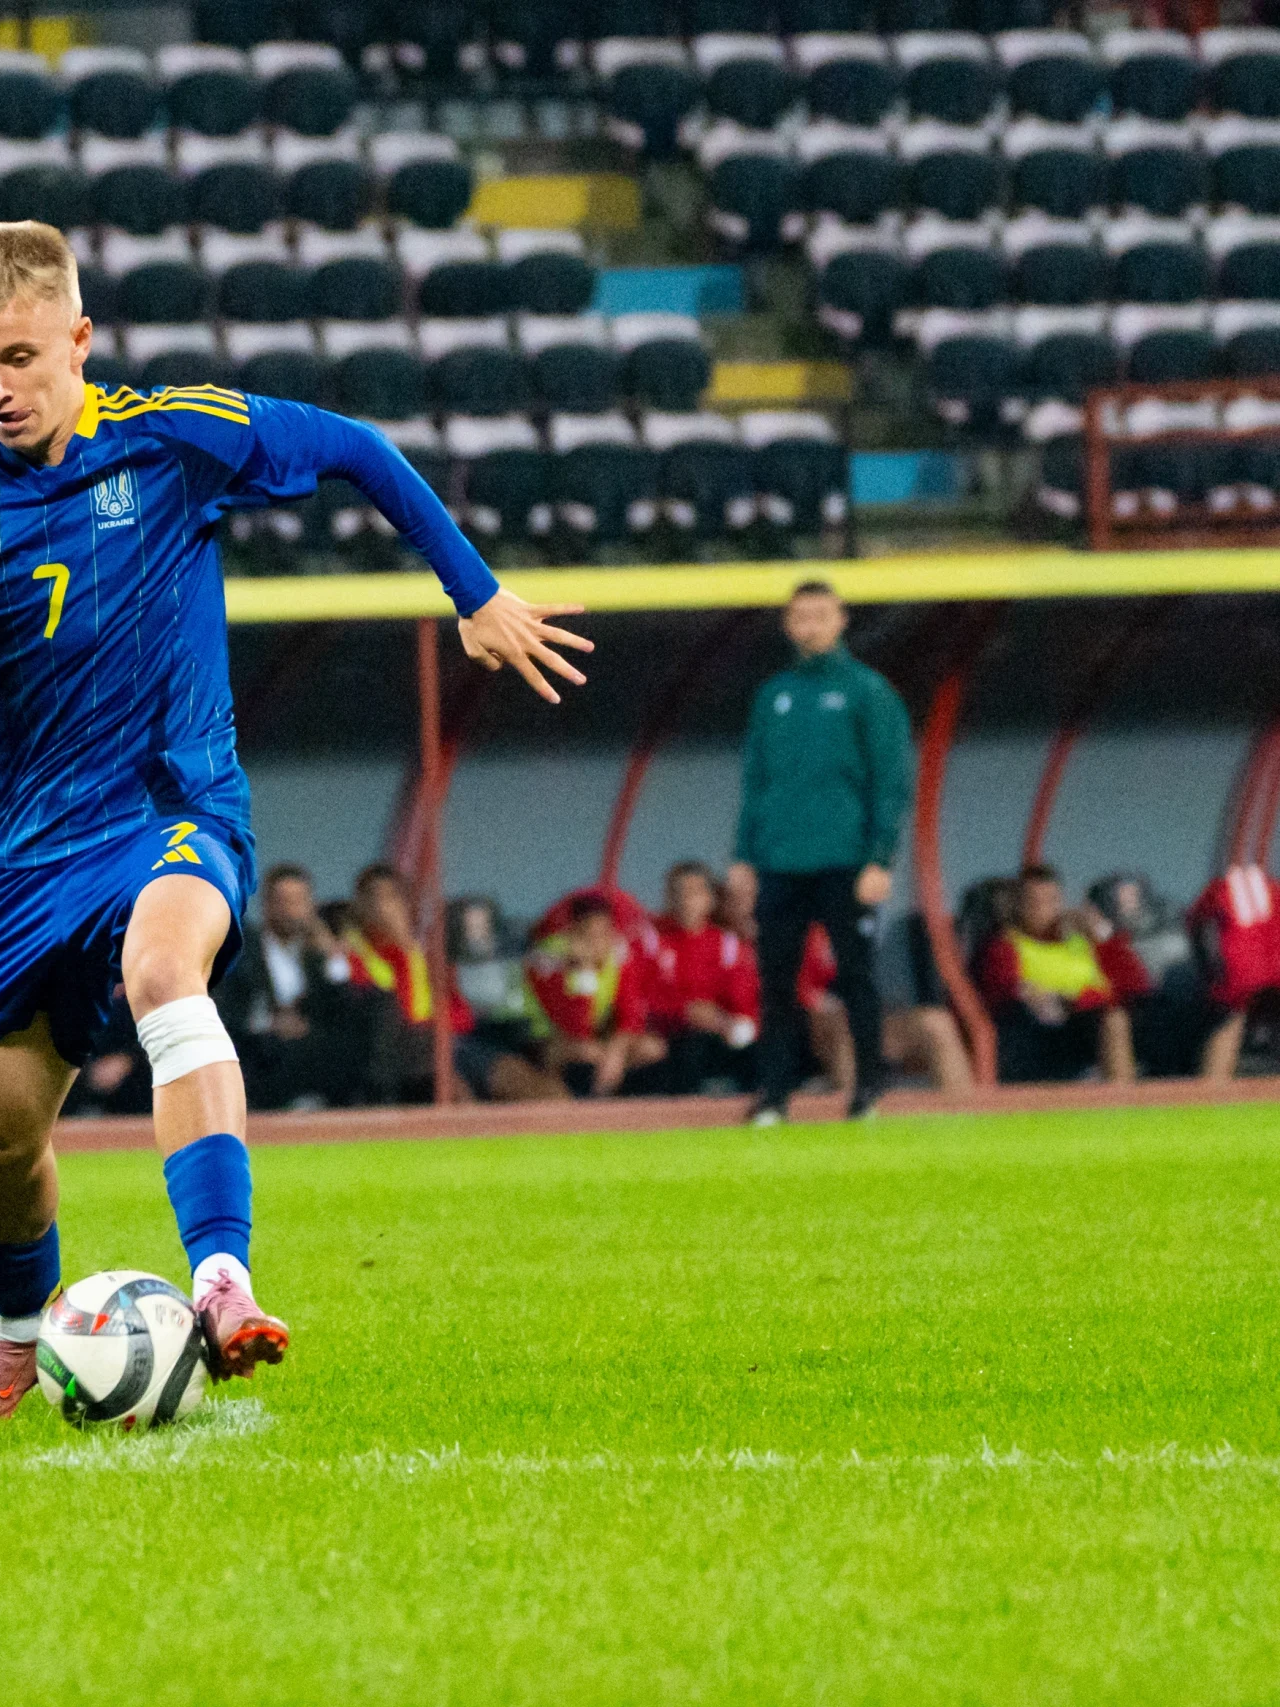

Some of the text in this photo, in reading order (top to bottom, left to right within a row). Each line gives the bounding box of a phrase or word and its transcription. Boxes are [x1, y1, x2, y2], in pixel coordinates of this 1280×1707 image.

[97, 517, 135, 530] UKRAINE
[32, 563, 70, 639] 7
[160, 821, 198, 847] 7
